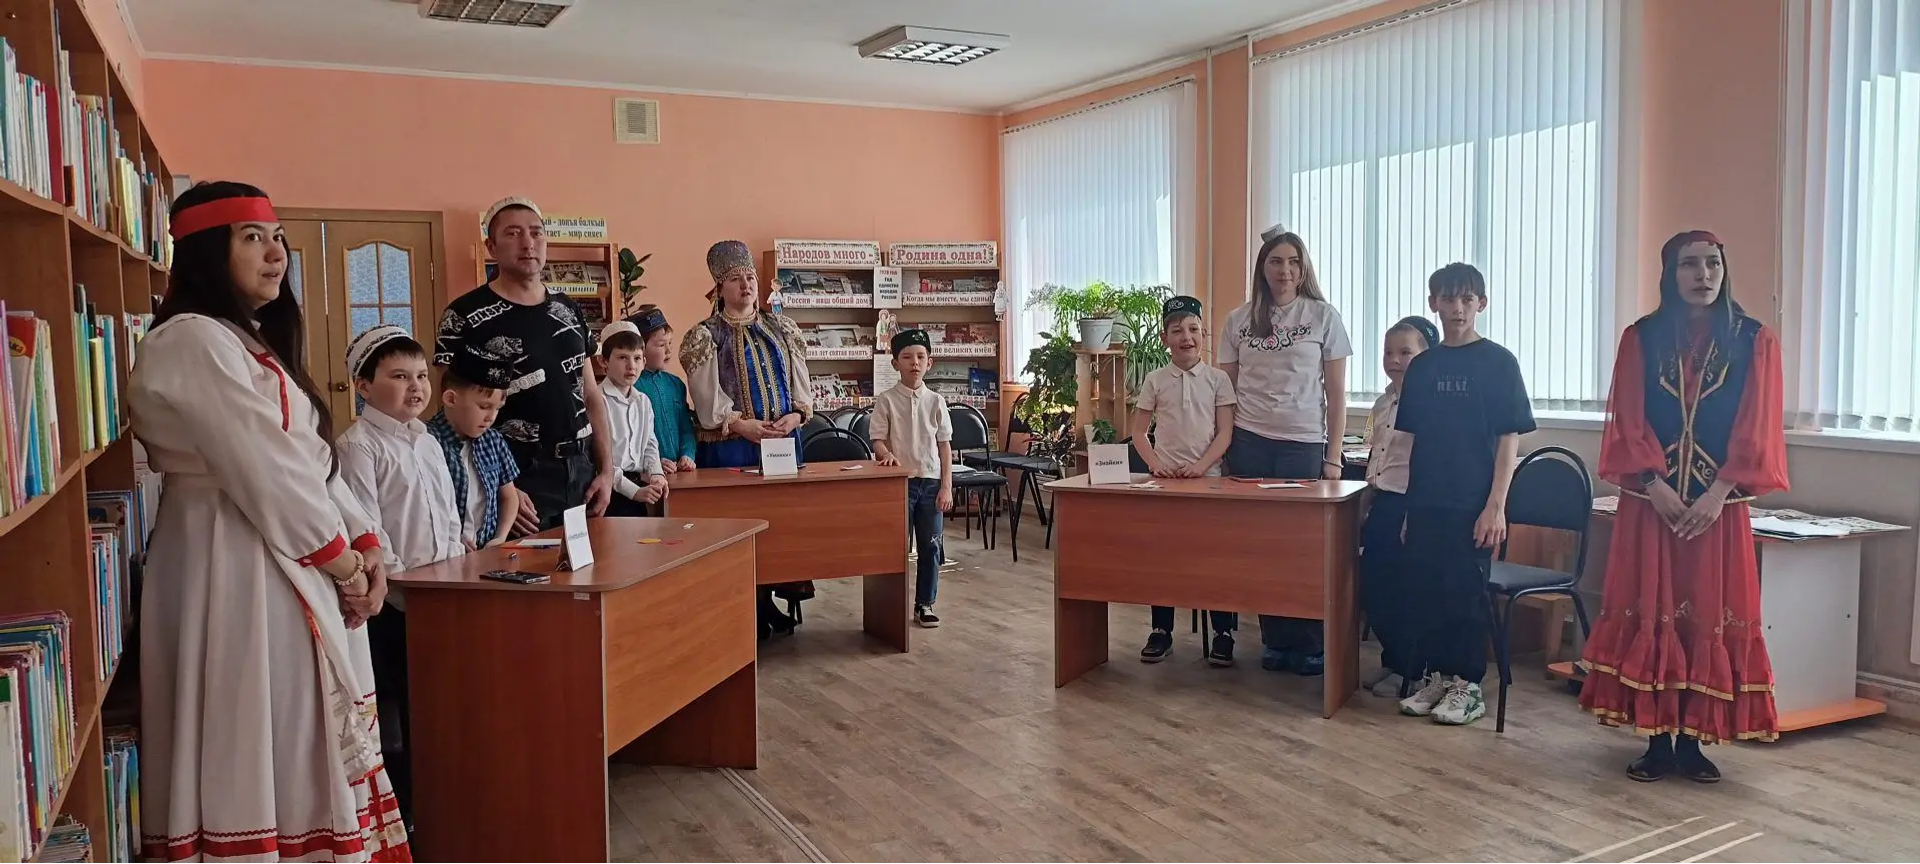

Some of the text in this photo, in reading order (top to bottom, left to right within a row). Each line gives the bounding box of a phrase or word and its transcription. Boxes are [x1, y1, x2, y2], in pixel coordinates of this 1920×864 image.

[782, 246, 831, 262] Народов
[833, 250, 866, 260] много
[896, 248, 987, 262] Родина одна!
[832, 295, 854, 305] общий
[855, 297, 869, 305] дом
[906, 295, 924, 303] Когда
